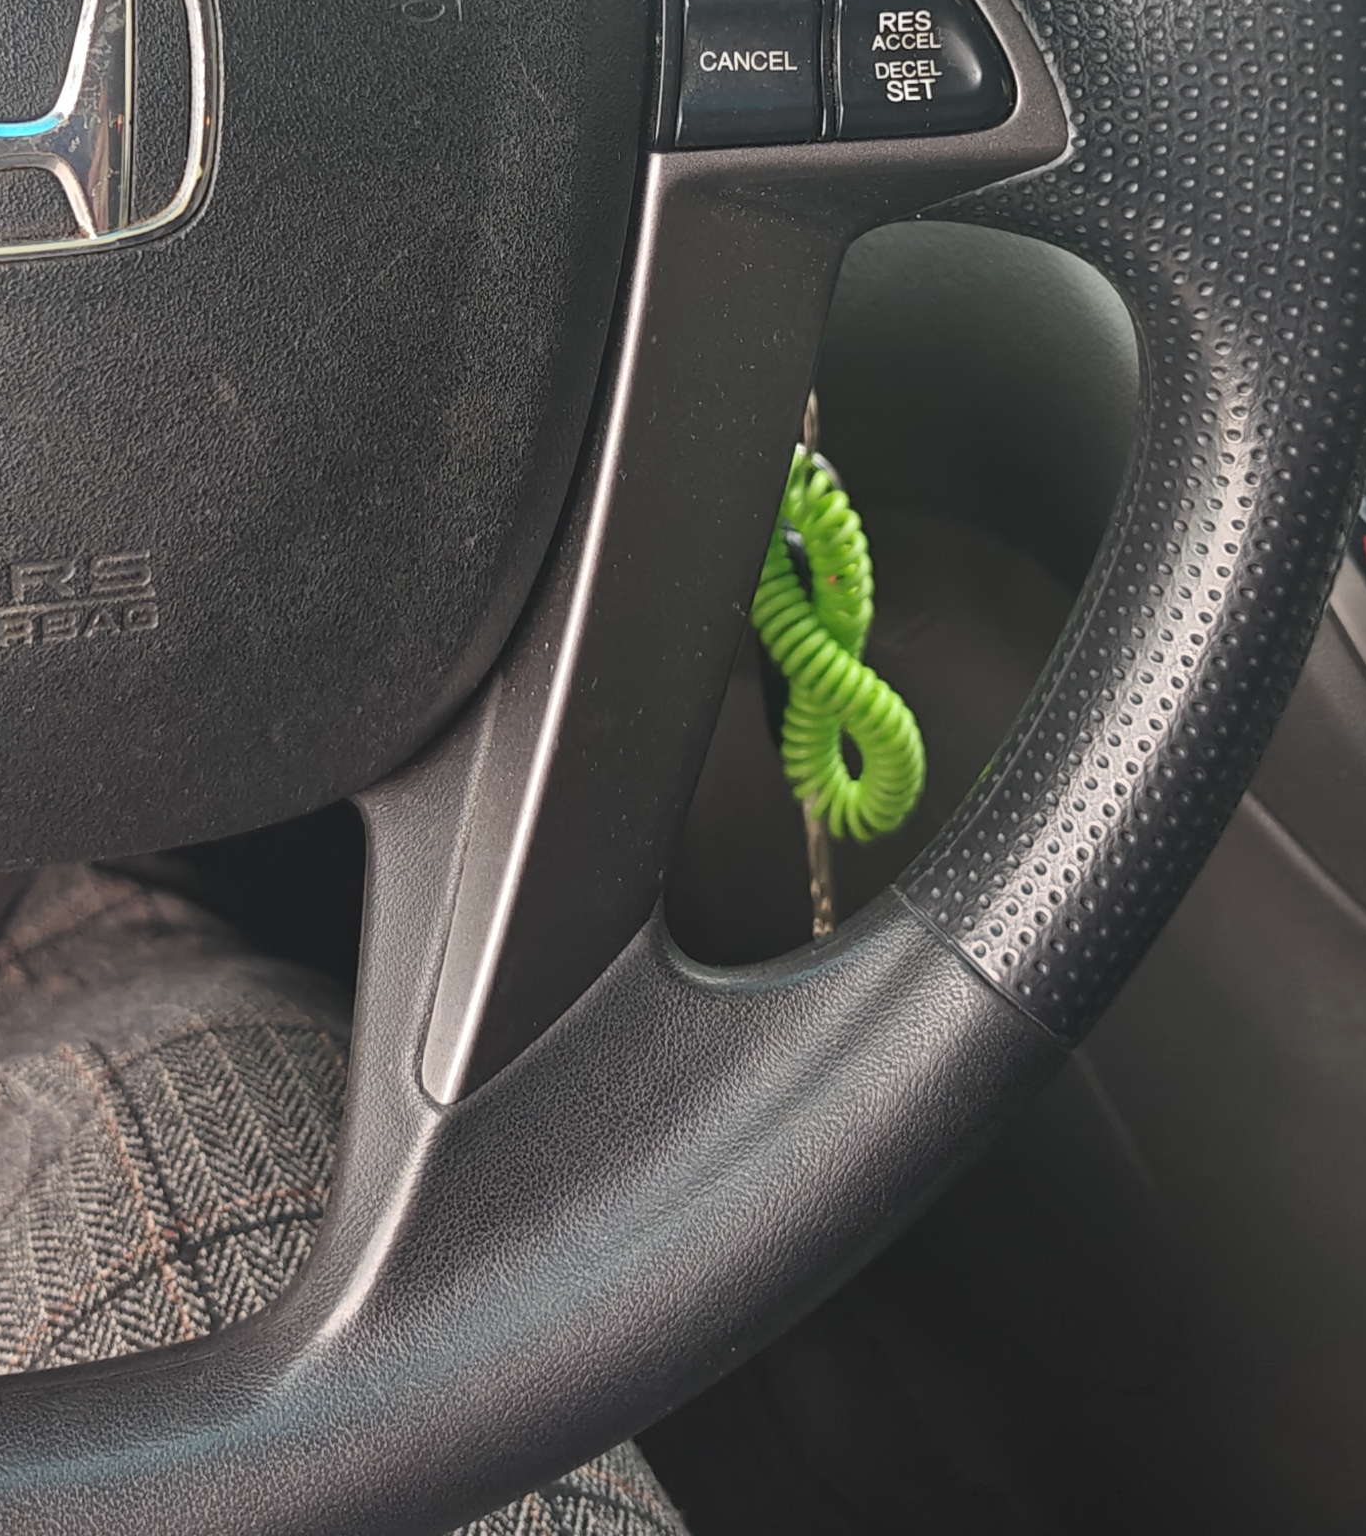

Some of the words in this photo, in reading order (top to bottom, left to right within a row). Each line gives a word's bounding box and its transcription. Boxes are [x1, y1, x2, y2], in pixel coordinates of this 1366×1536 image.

[879, 11, 932, 32] RES
[871, 33, 942, 51] ACCEL
[699, 50, 798, 73] CANCEL
[874, 60, 942, 80] DECEL
[886, 80, 936, 102] SET
